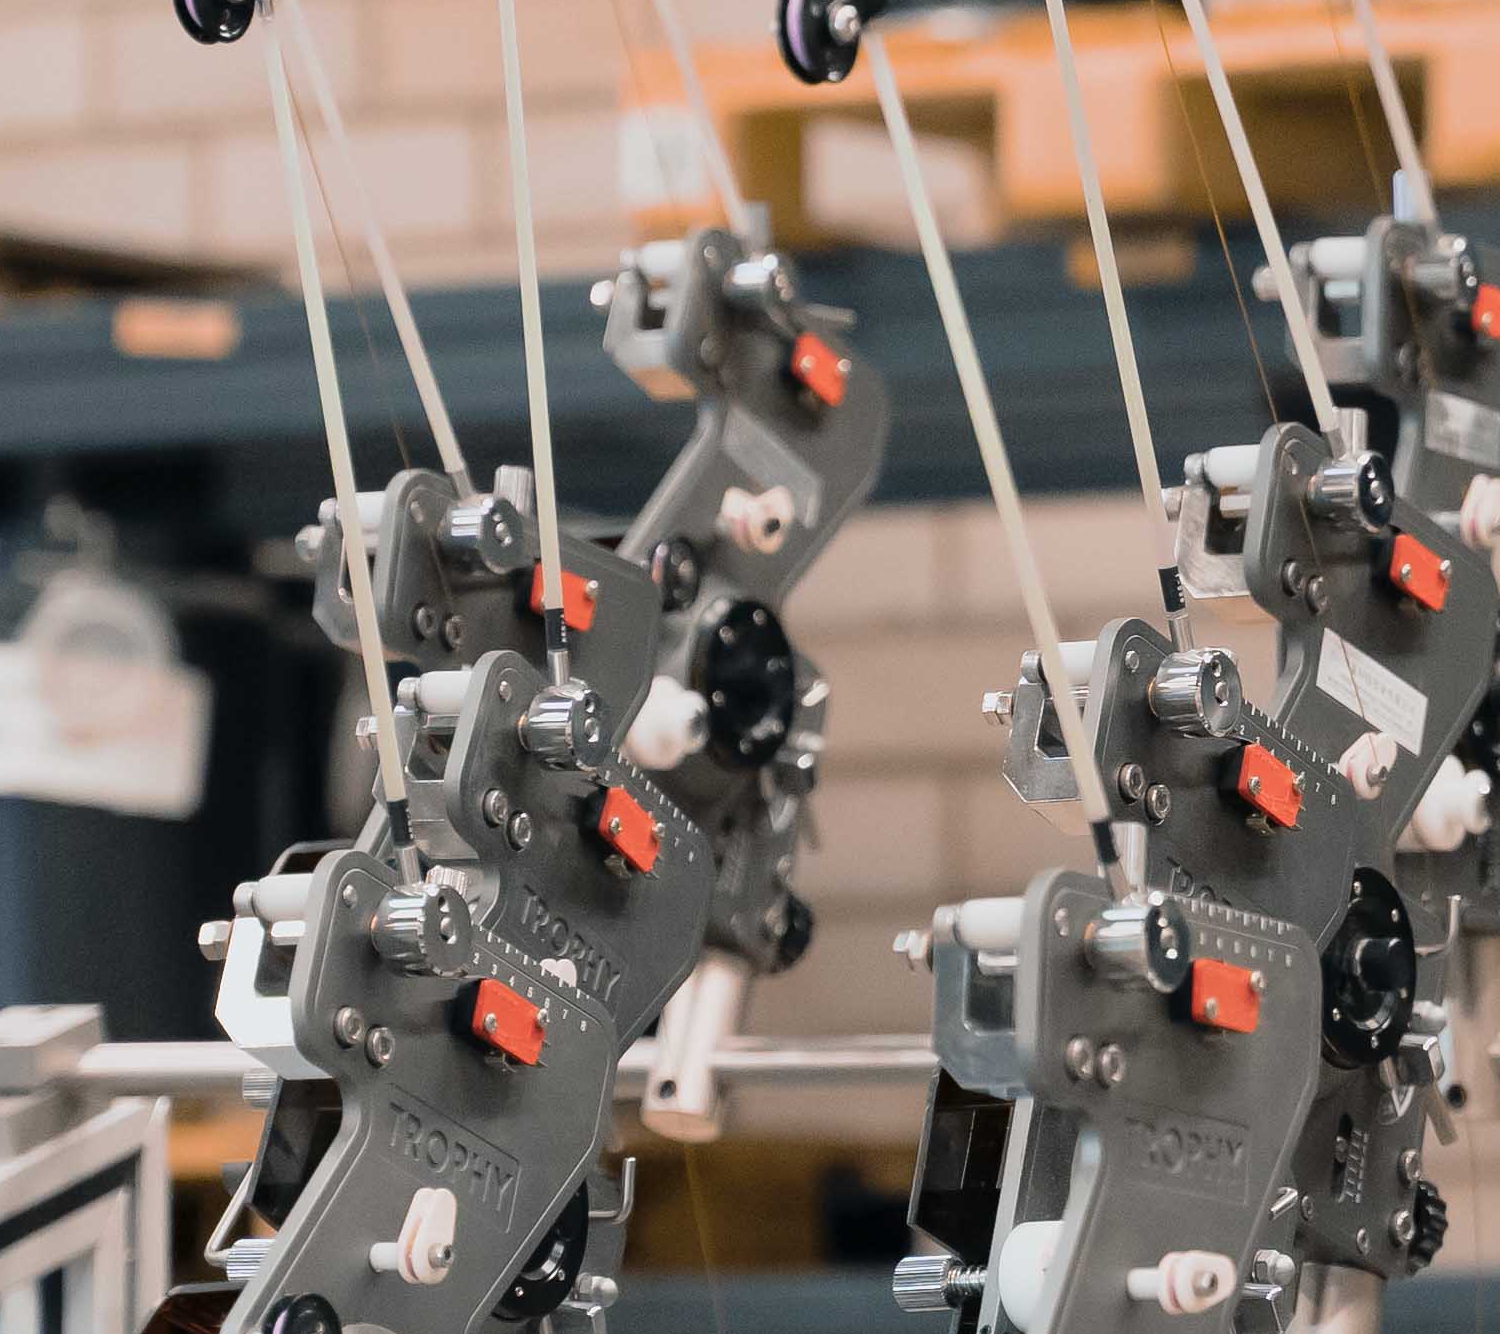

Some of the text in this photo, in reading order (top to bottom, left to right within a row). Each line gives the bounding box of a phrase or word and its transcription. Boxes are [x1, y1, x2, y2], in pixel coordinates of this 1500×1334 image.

[473, 952, 480, 965] 2
[492, 964, 498, 976] 3
[509, 975, 515, 987] 4
[527, 986, 533, 998] 5
[562, 1009, 568, 1020] 7
[580, 1020, 587, 1032] 8
[522, 884, 621, 1003] TROPHY
[389, 1101, 514, 1212] TROPHY
